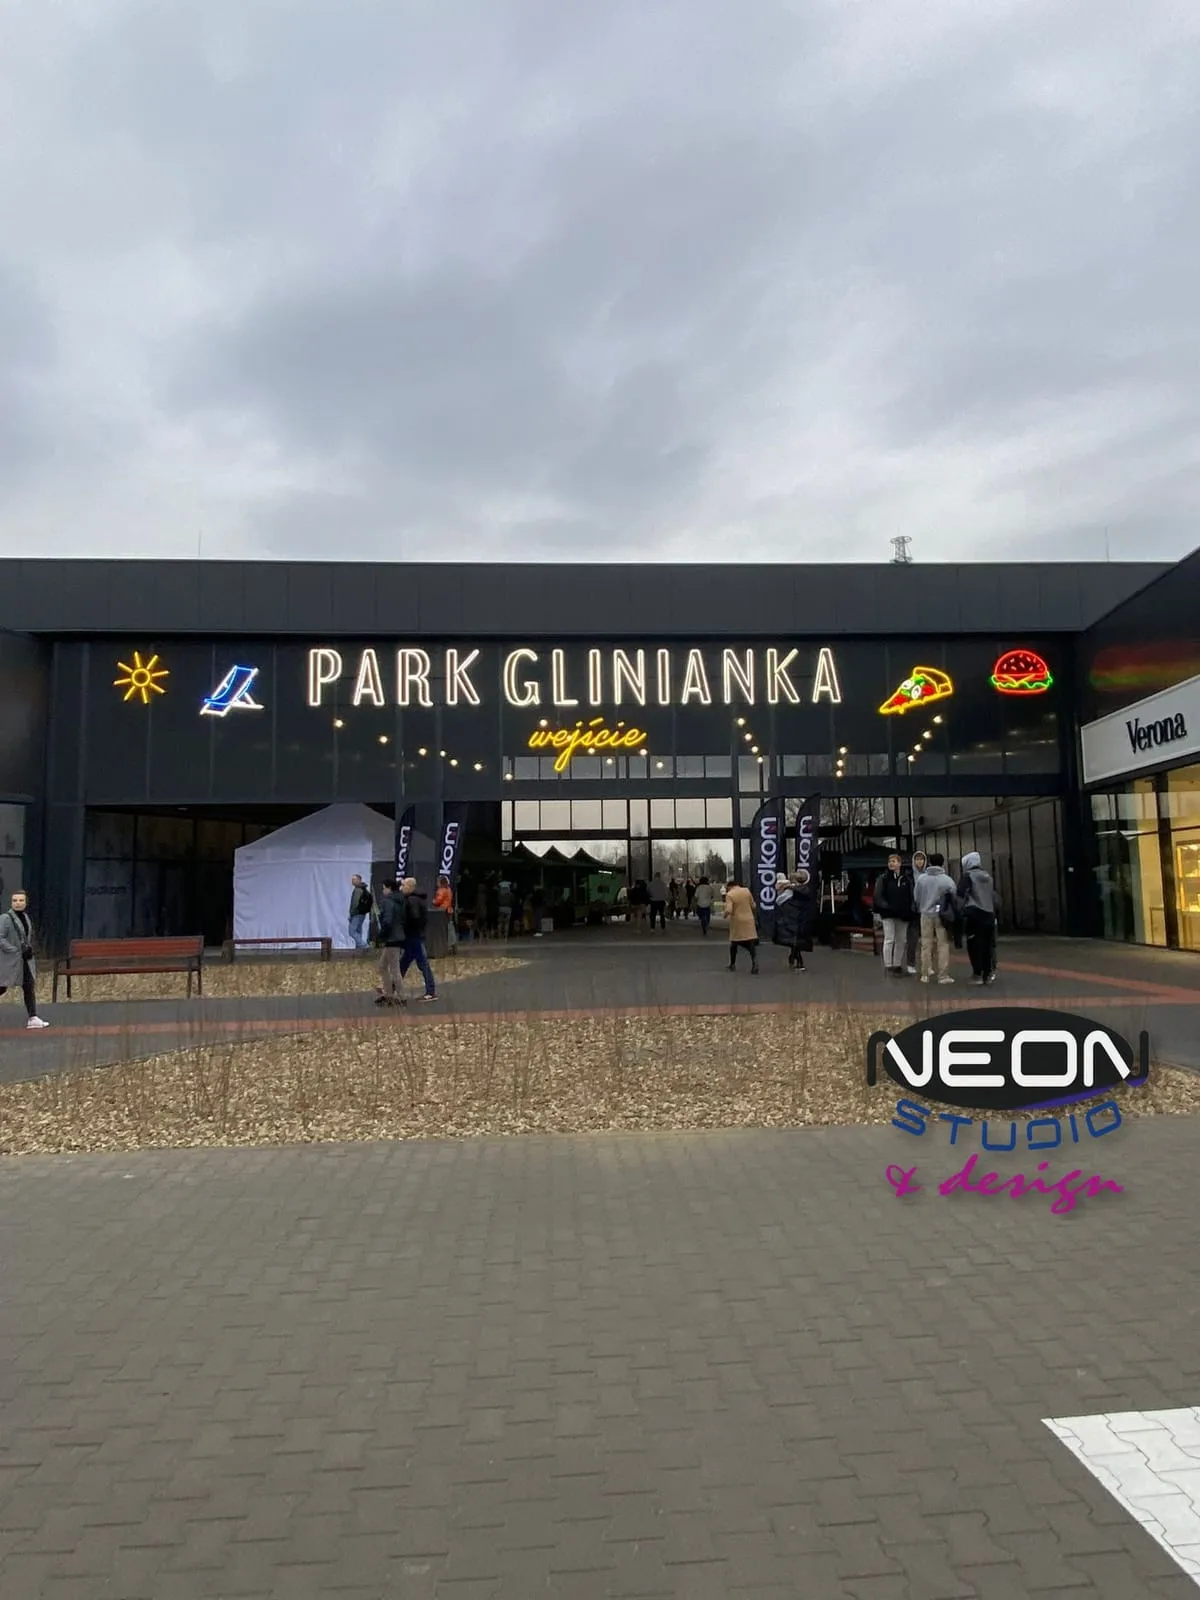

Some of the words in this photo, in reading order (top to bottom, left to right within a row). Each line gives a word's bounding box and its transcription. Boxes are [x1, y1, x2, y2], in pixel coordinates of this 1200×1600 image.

[307, 647, 481, 707] PARK
[503, 647, 841, 706] GLINIANKA
[529, 717, 646, 772] wejście
[1125, 712, 1187, 755] Verona
[757, 816, 777, 911] redkom
